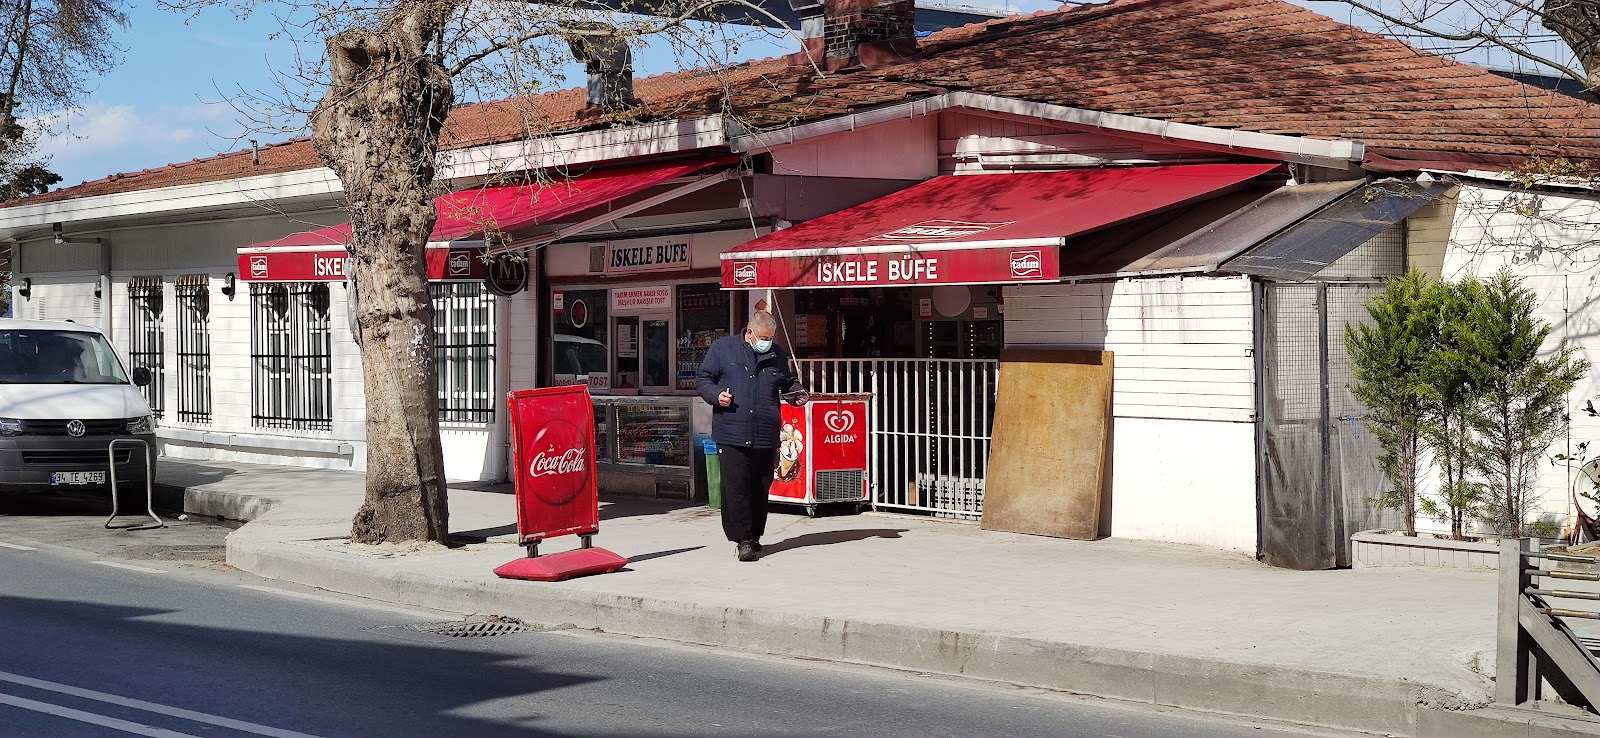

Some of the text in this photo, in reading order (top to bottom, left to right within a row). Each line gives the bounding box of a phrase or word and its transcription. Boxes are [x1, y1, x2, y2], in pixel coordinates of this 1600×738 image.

[610, 240, 688, 267] İSKELE BÜFE
[314, 254, 347, 276] İSKEL
[817, 254, 938, 282] İSKELE BÜFE
[1011, 259, 1039, 270] tadım
[628, 290, 642, 298] EKMEK
[589, 376, 608, 386] TOST
[530, 447, 586, 477] Coca-Cola
[56, 472, 103, 482] 34 TE 4269
